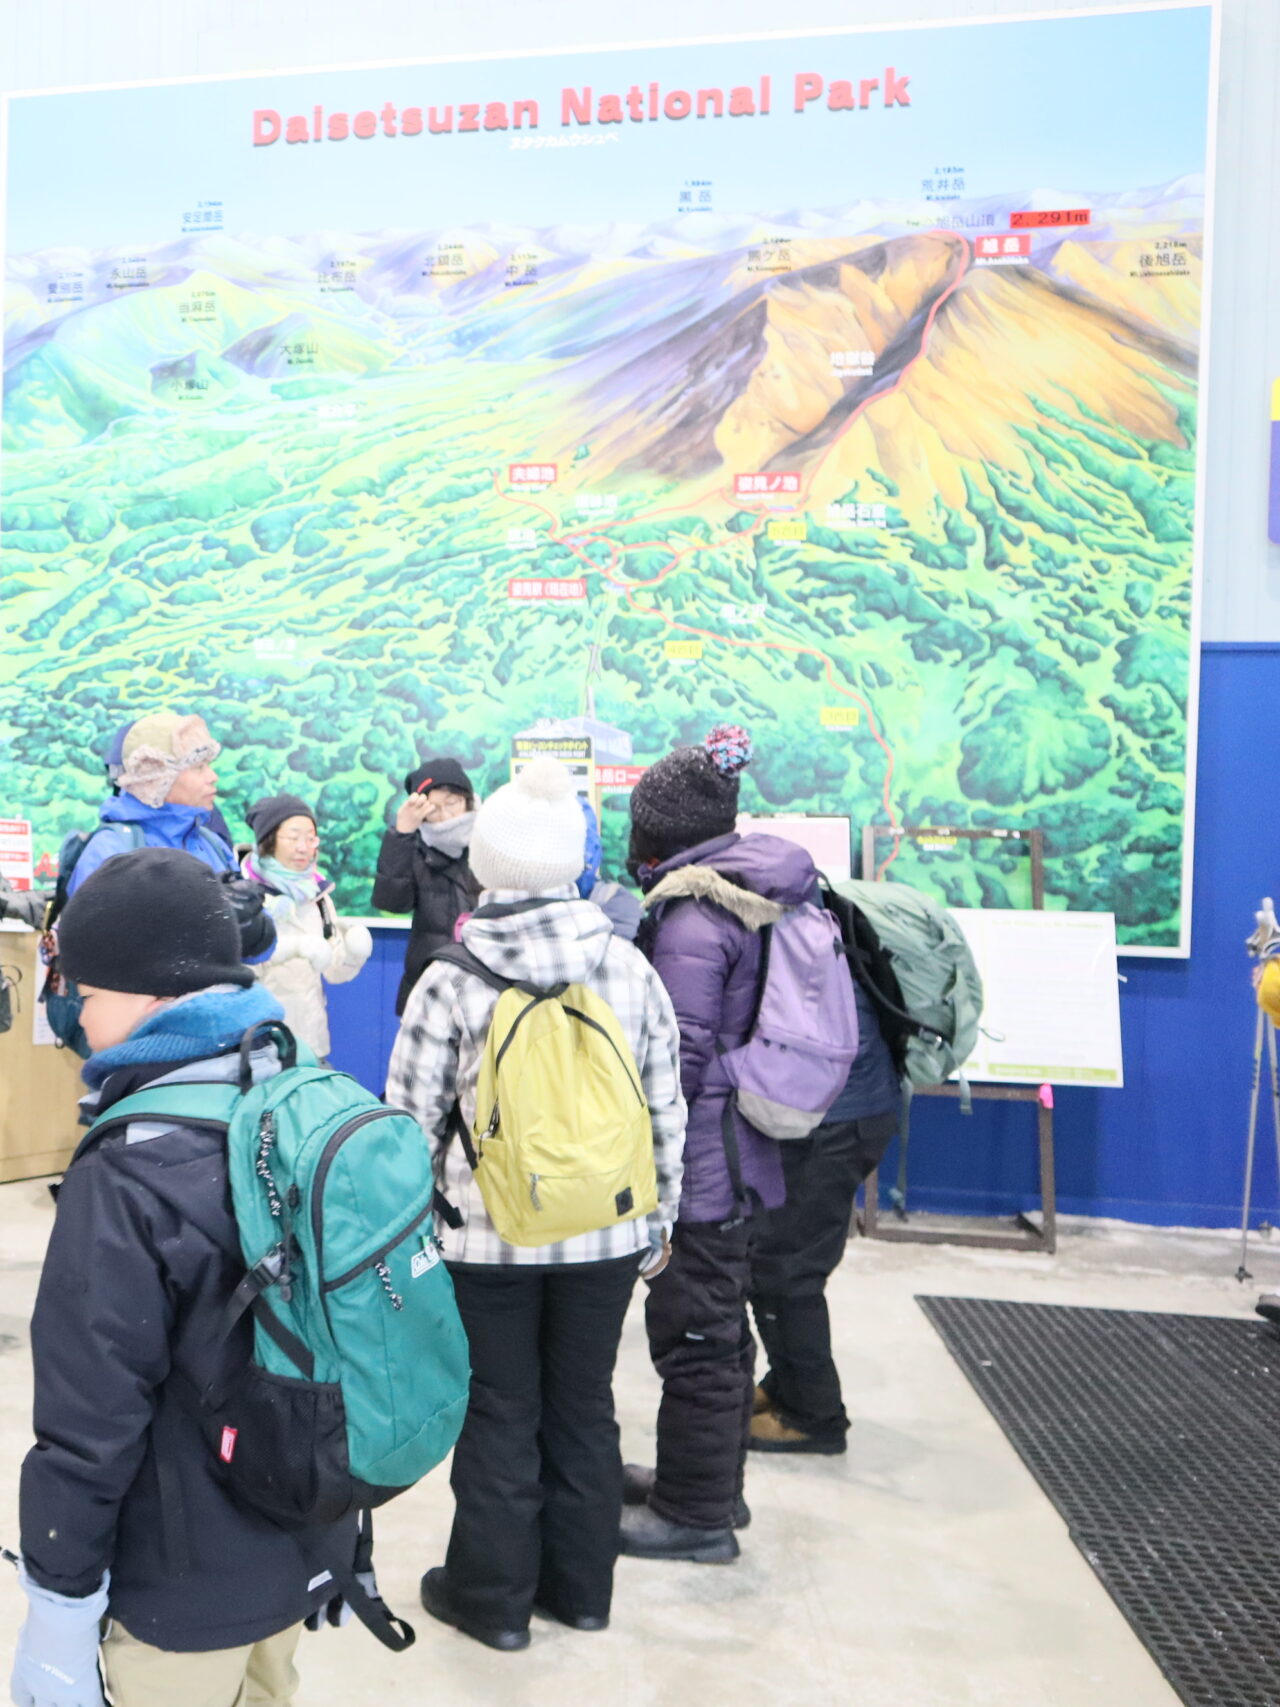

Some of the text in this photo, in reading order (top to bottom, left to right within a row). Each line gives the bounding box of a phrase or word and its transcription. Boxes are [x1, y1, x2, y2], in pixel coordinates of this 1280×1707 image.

[251, 66, 912, 147] Daisetsuzan National Park
